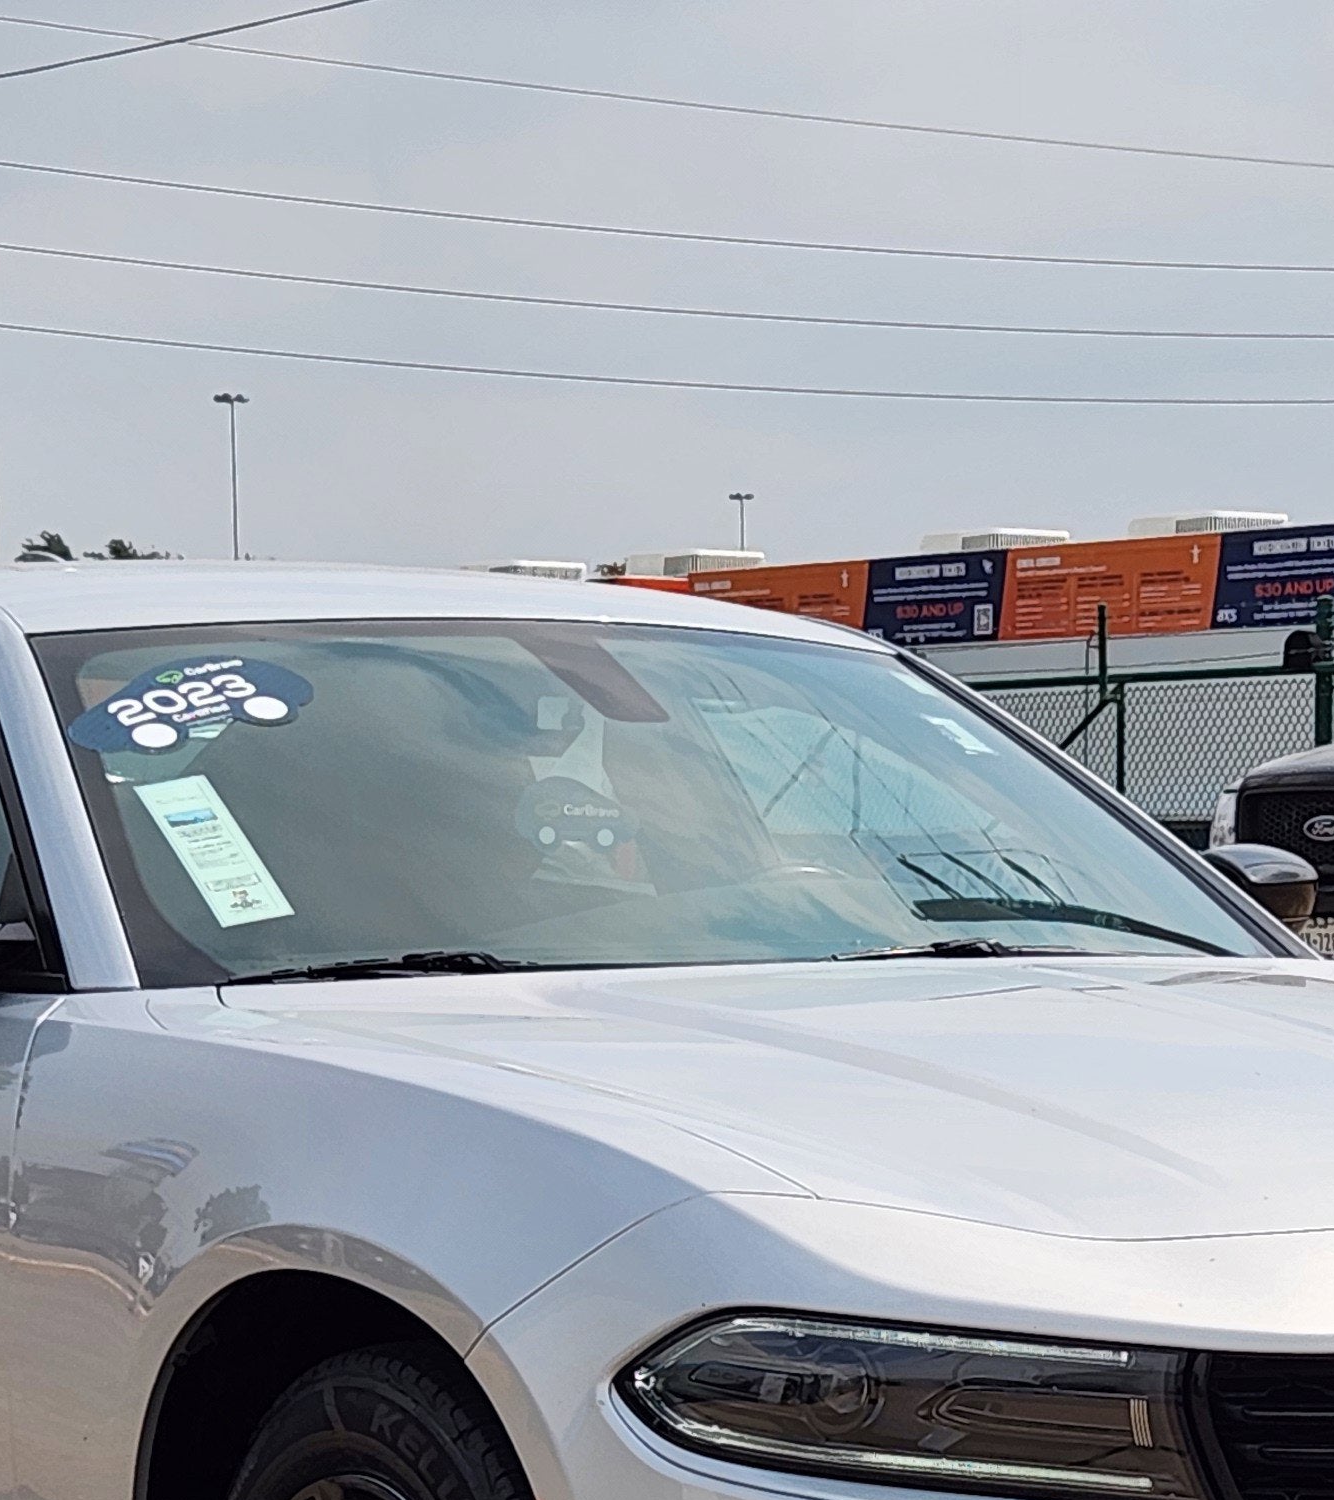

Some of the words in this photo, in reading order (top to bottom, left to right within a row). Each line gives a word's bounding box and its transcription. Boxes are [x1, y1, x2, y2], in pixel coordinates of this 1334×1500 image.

[1284, 581, 1313, 596] AND
[920, 603, 947, 618] AND
[107, 673, 257, 727] 2023
